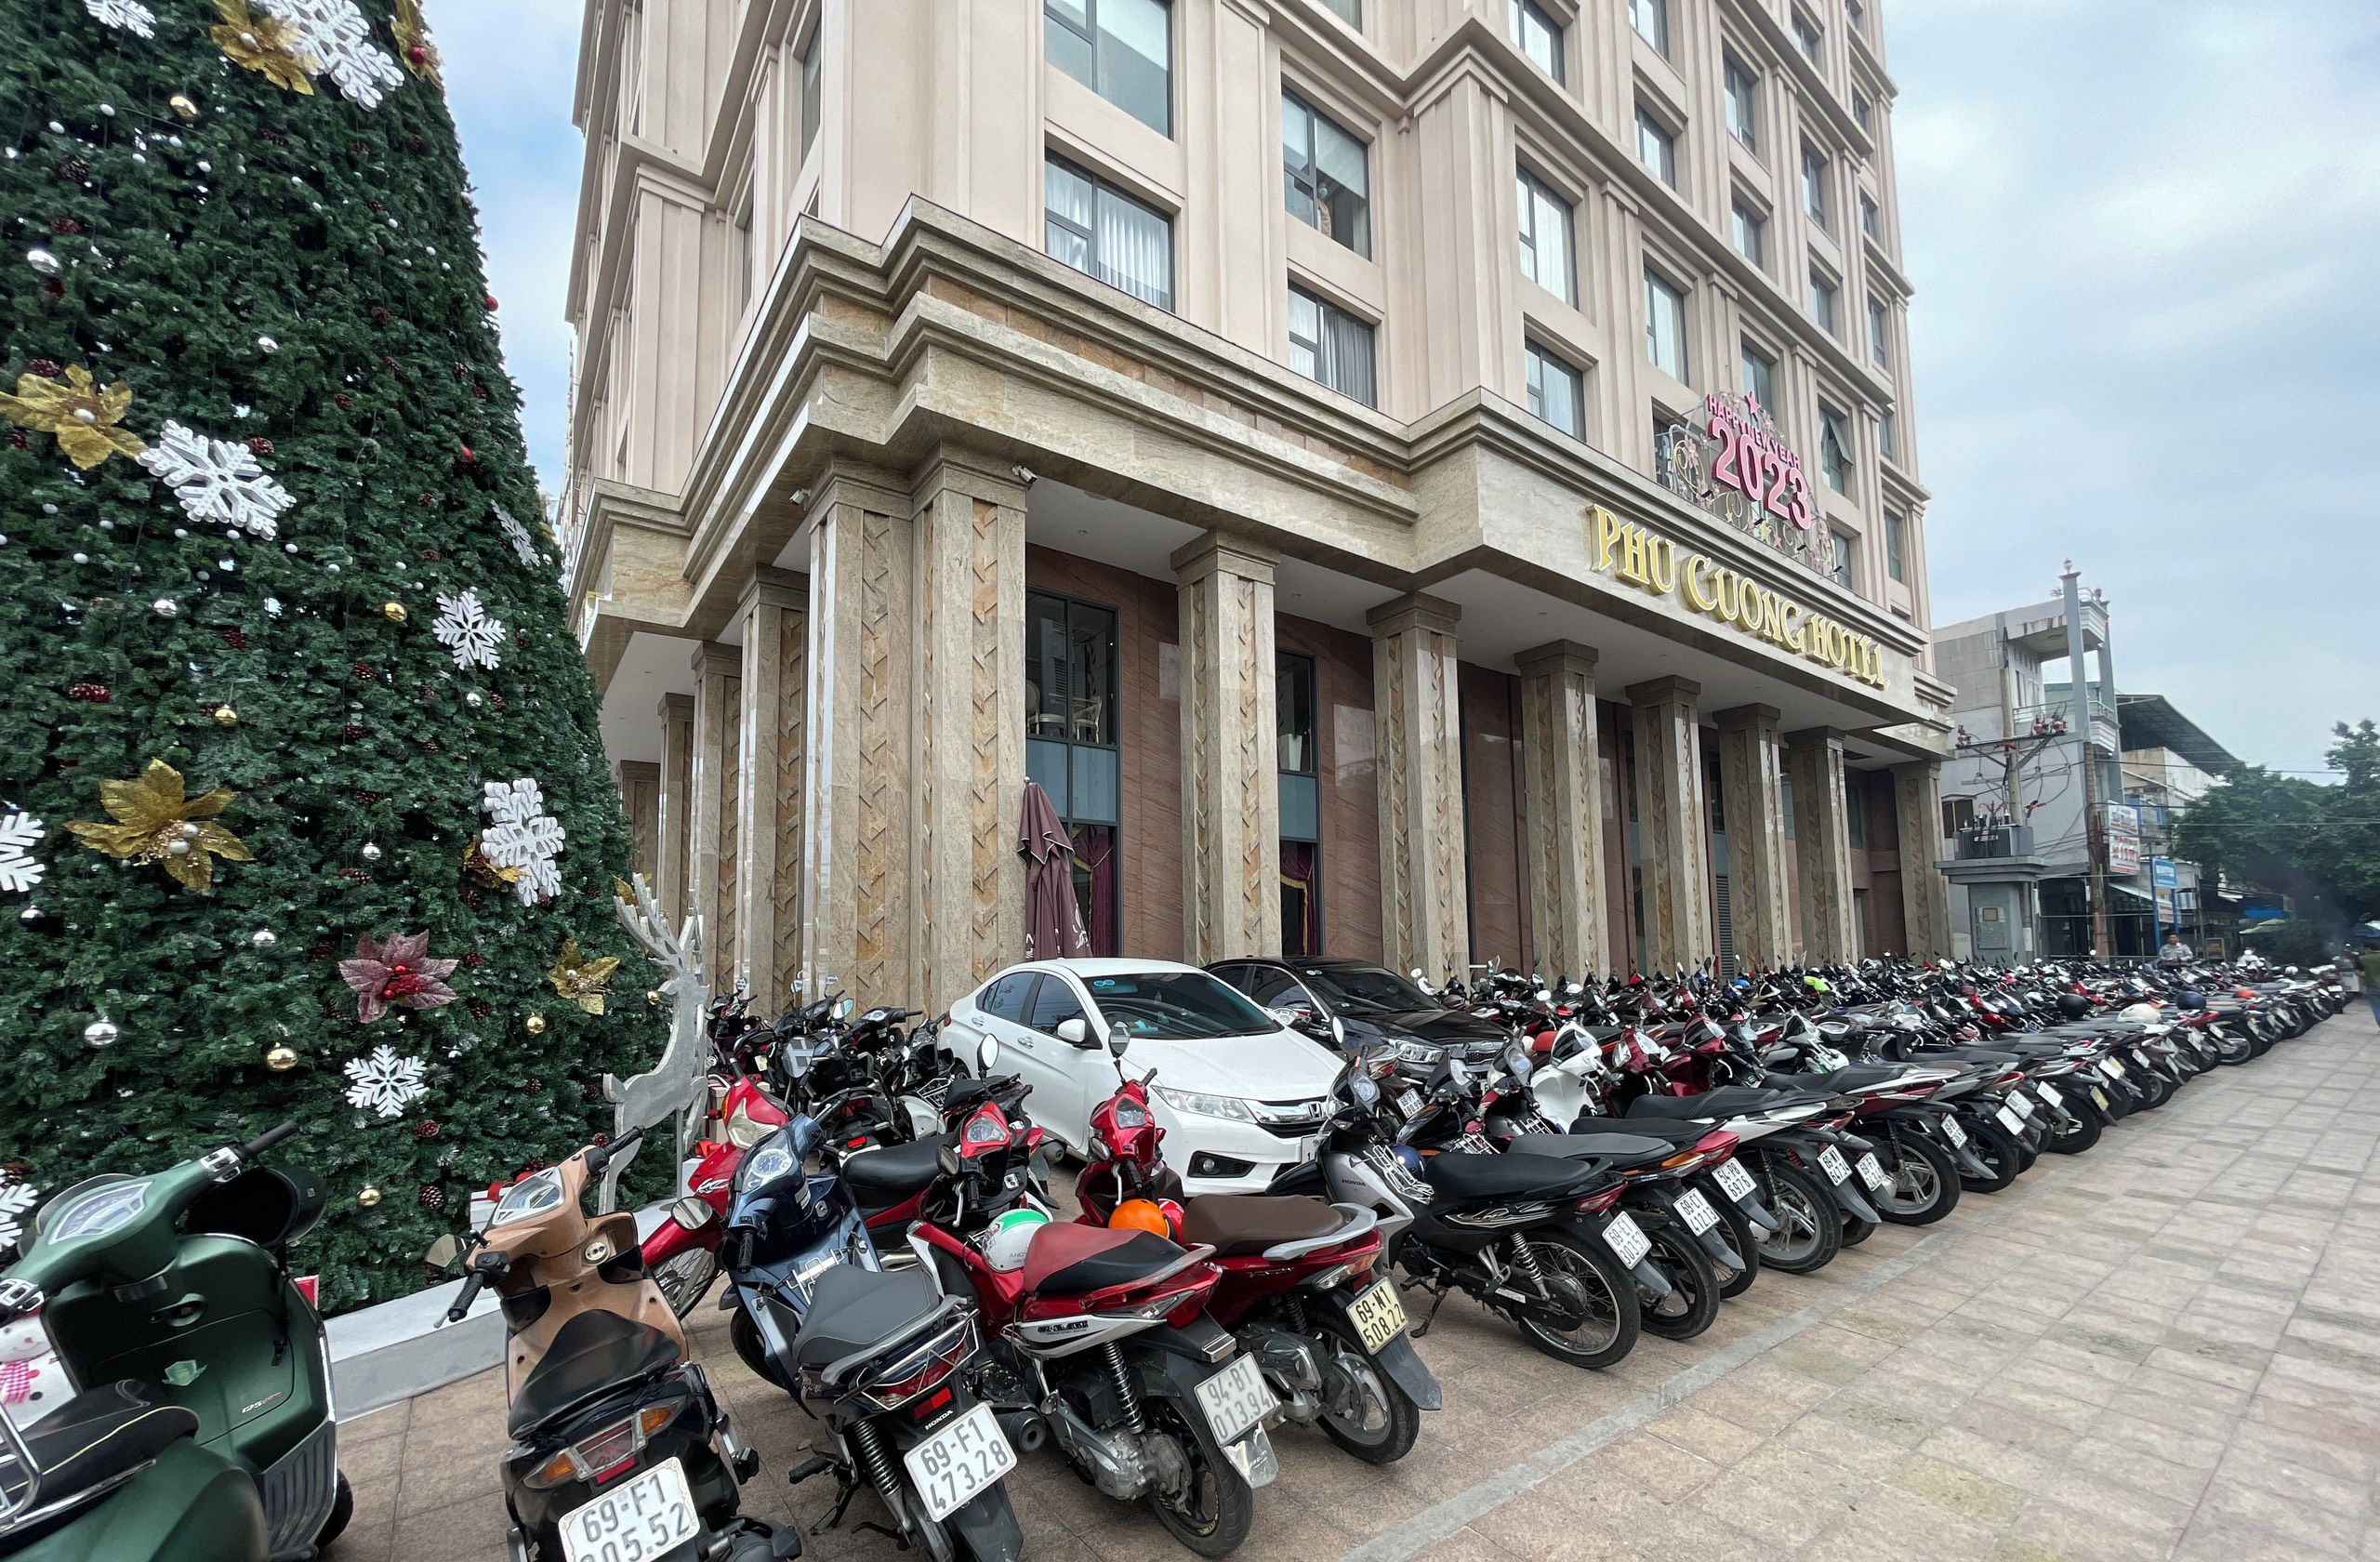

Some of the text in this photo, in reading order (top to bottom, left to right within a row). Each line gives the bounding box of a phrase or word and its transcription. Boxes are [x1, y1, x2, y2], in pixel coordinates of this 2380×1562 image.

[1707, 394, 1746, 434] HAPPY
[1769, 438, 1802, 470] YEAR
[1709, 417, 1812, 530] 2023
[1591, 503, 1891, 691] PHU CUONG HOTEL
[1342, 1178, 1366, 1186] HONDA
[1727, 1175, 1752, 1198] 6976
[1362, 1303, 1406, 1349] 508.22
[924, 1409, 955, 1431] HONDA
[1213, 1384, 1271, 1439] 013.94
[919, 1416, 985, 1476] 69-F1
[929, 1439, 1009, 1510] 473.28
